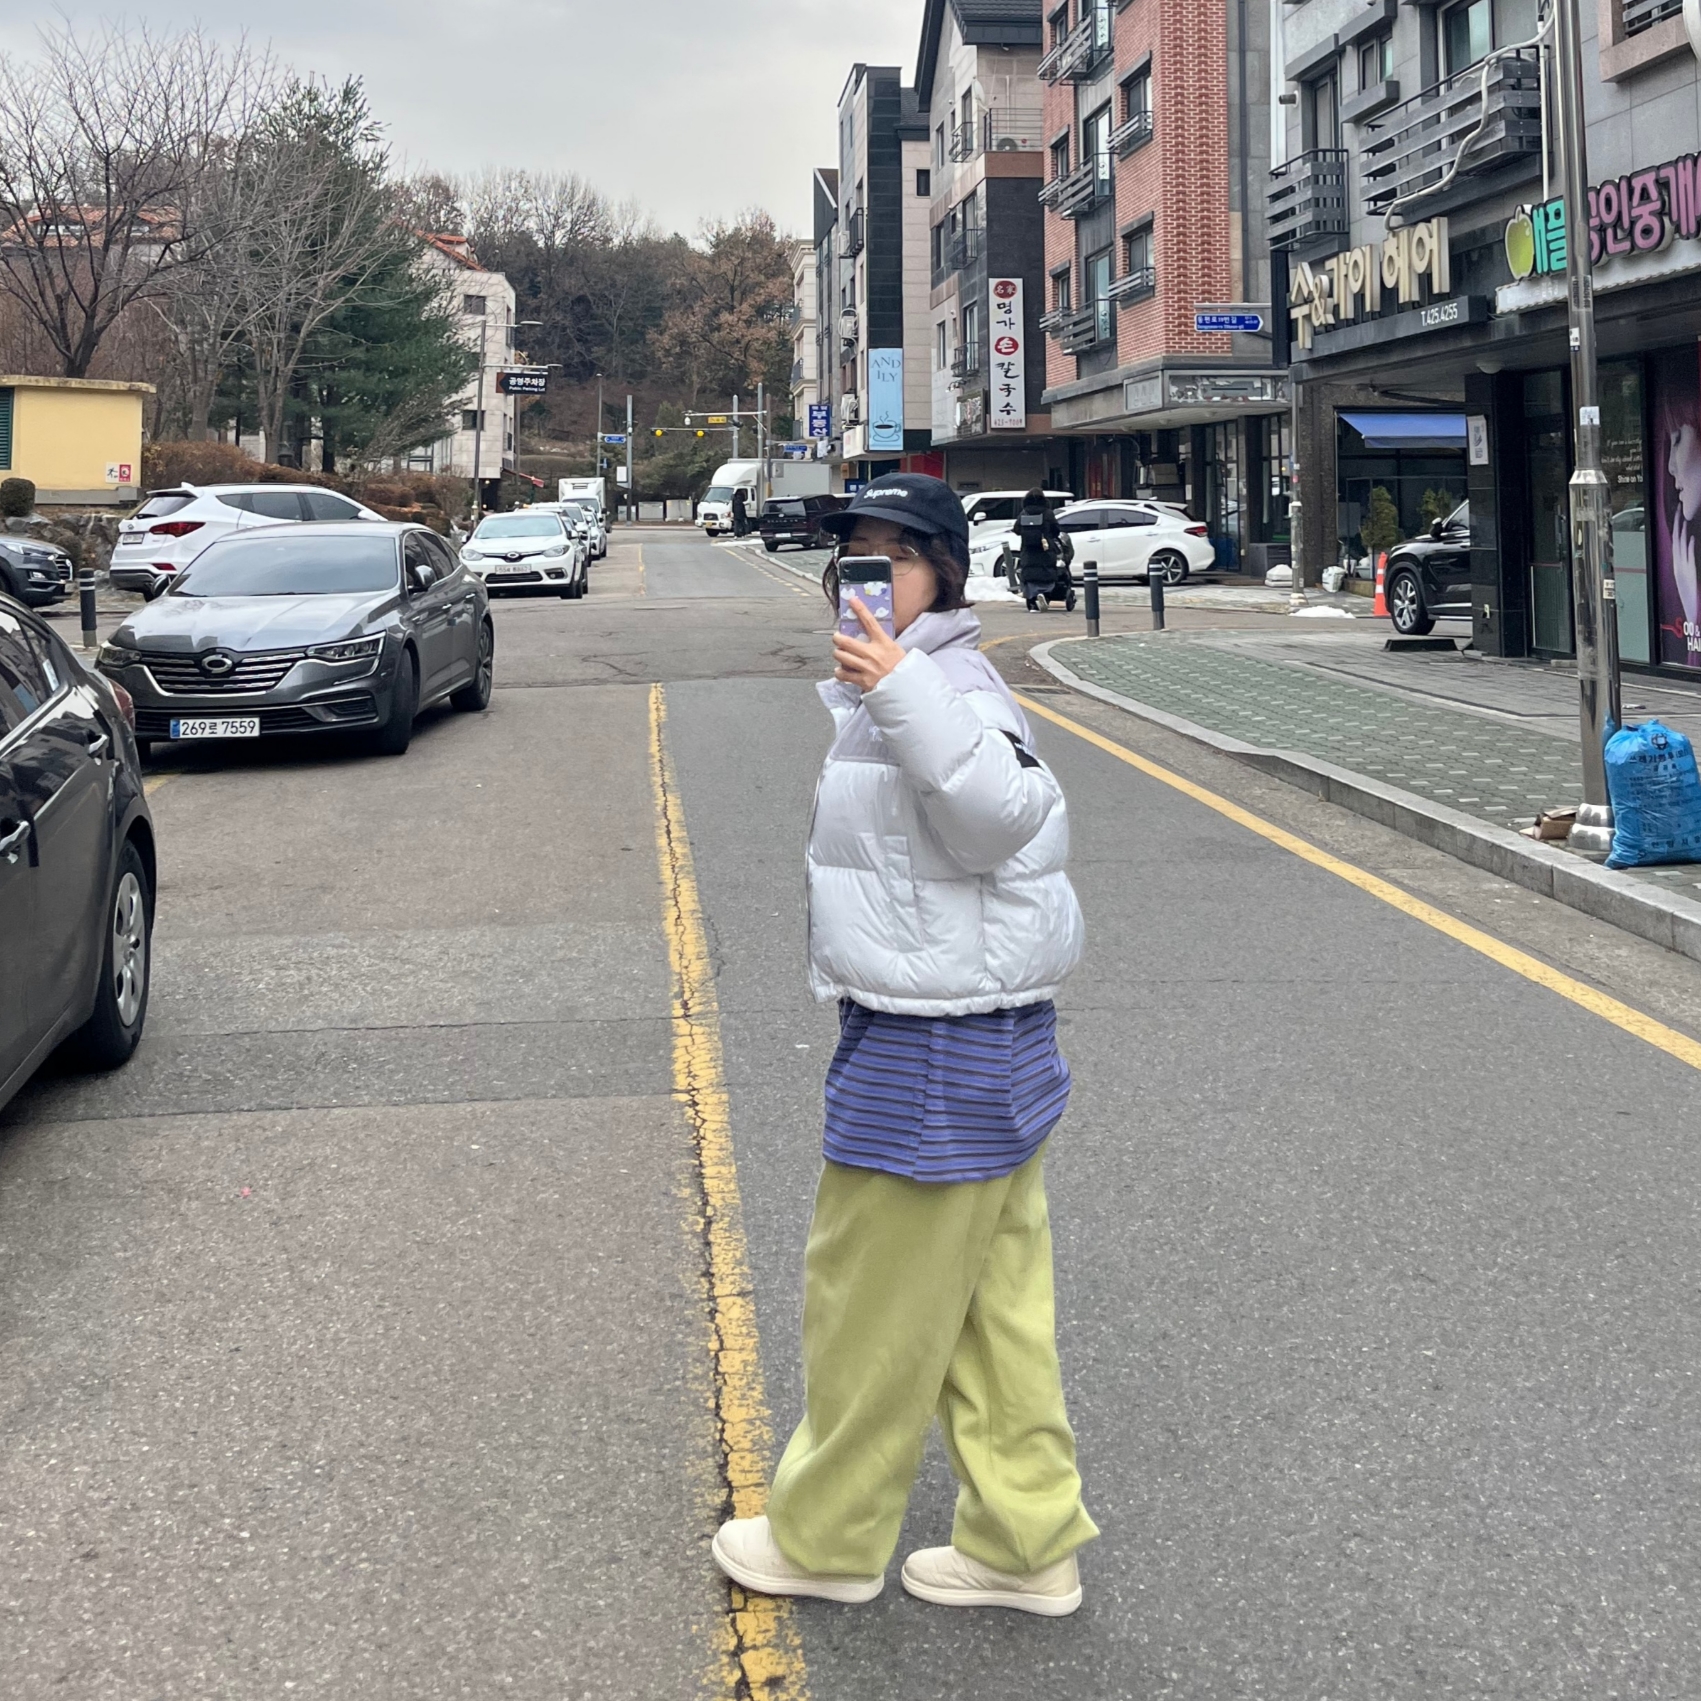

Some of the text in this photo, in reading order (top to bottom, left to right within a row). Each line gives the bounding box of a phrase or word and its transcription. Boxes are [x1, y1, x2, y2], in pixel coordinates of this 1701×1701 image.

[1588, 154, 1701, 263] 인중개
[1382, 217, 1450, 304] 헤어
[1420, 302, 1458, 326] T.425.4255
[871, 357, 901, 369] AND
[509, 376, 546, 387] 공영주차장
[877, 370, 898, 382] ILY
[812, 411, 828, 437] 부동산
[863, 488, 909, 499] Supreme
[181, 720, 256, 736] 269로 7559
